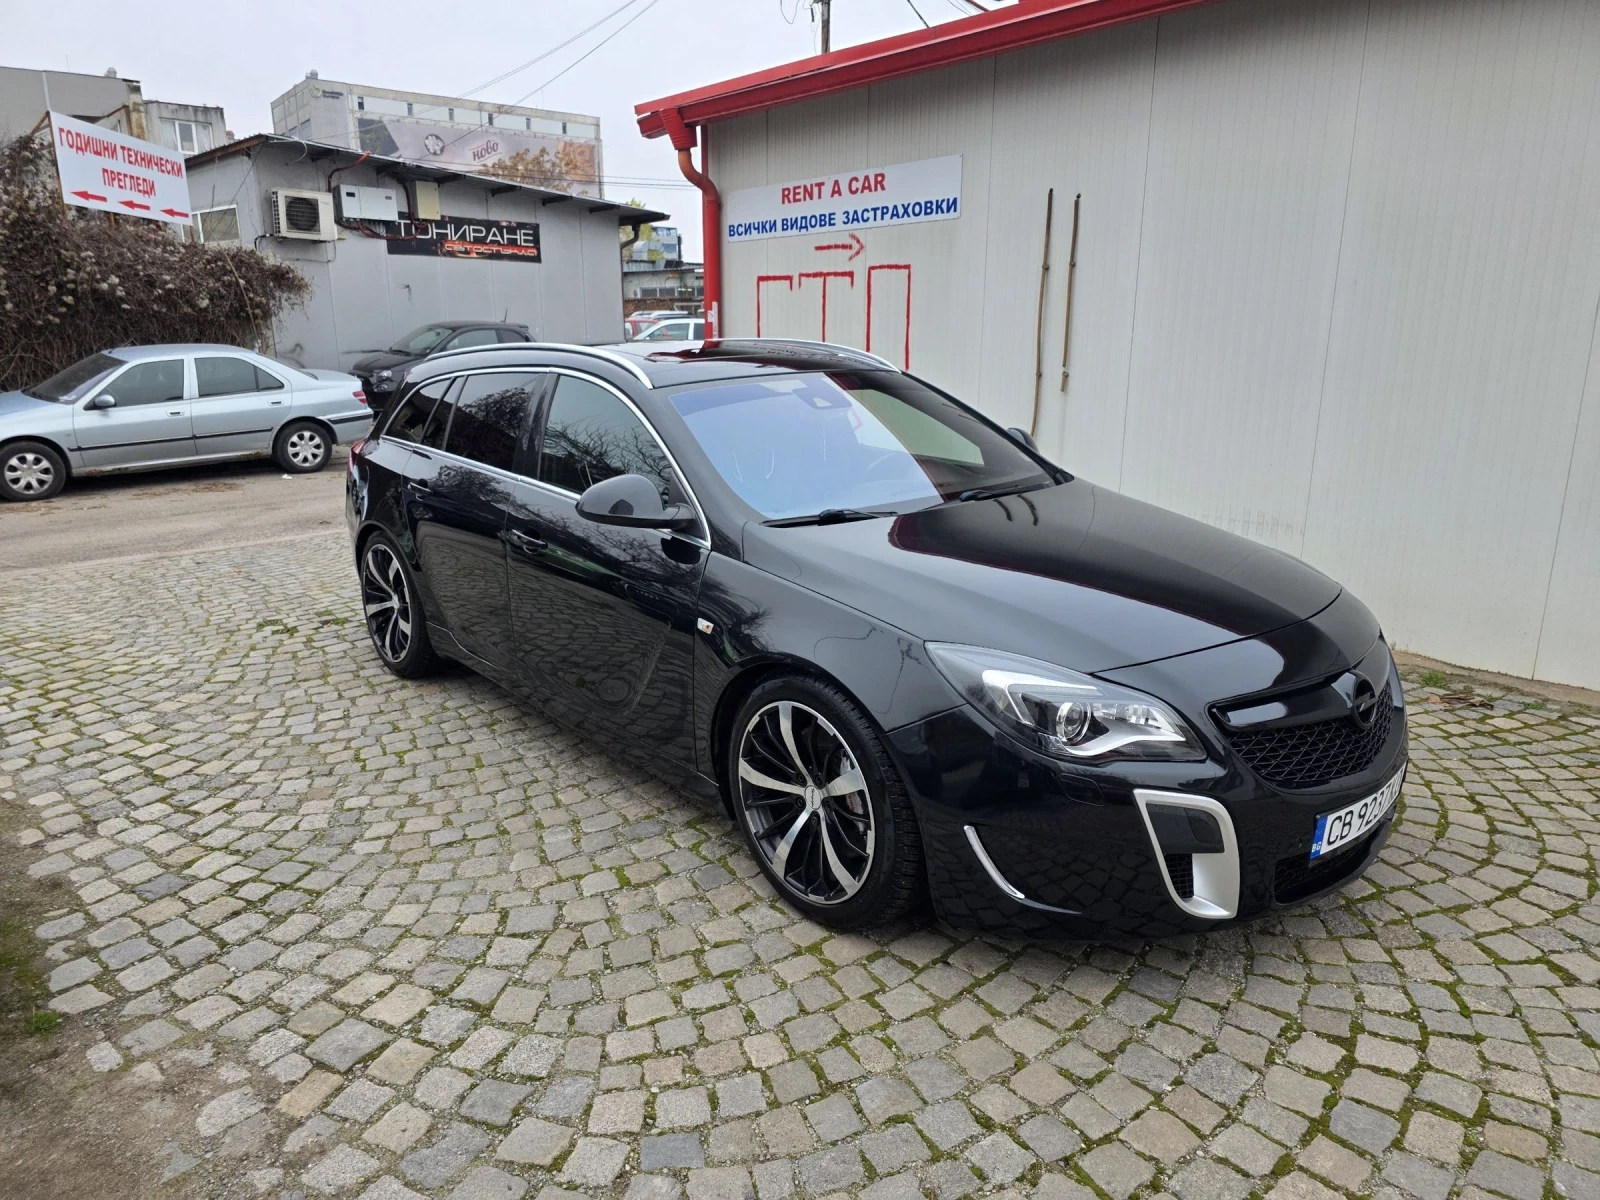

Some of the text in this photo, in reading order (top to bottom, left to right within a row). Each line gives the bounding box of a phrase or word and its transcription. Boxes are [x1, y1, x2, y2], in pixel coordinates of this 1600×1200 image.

[58, 127, 183, 178] ГОДИШНИ ТЕХНИЧЕСКИ
[472, 139, 499, 162] ново
[102, 168, 156, 198] ПРЕГЛЕДИ
[781, 172, 886, 205] RENT A CAR
[728, 197, 958, 238] ВСИЧКИ ВИДОВЕ ЗАСТРАХОВКИ
[398, 219, 534, 247] ТОНИРАНЕ
[1311, 841, 1322, 853] BG
